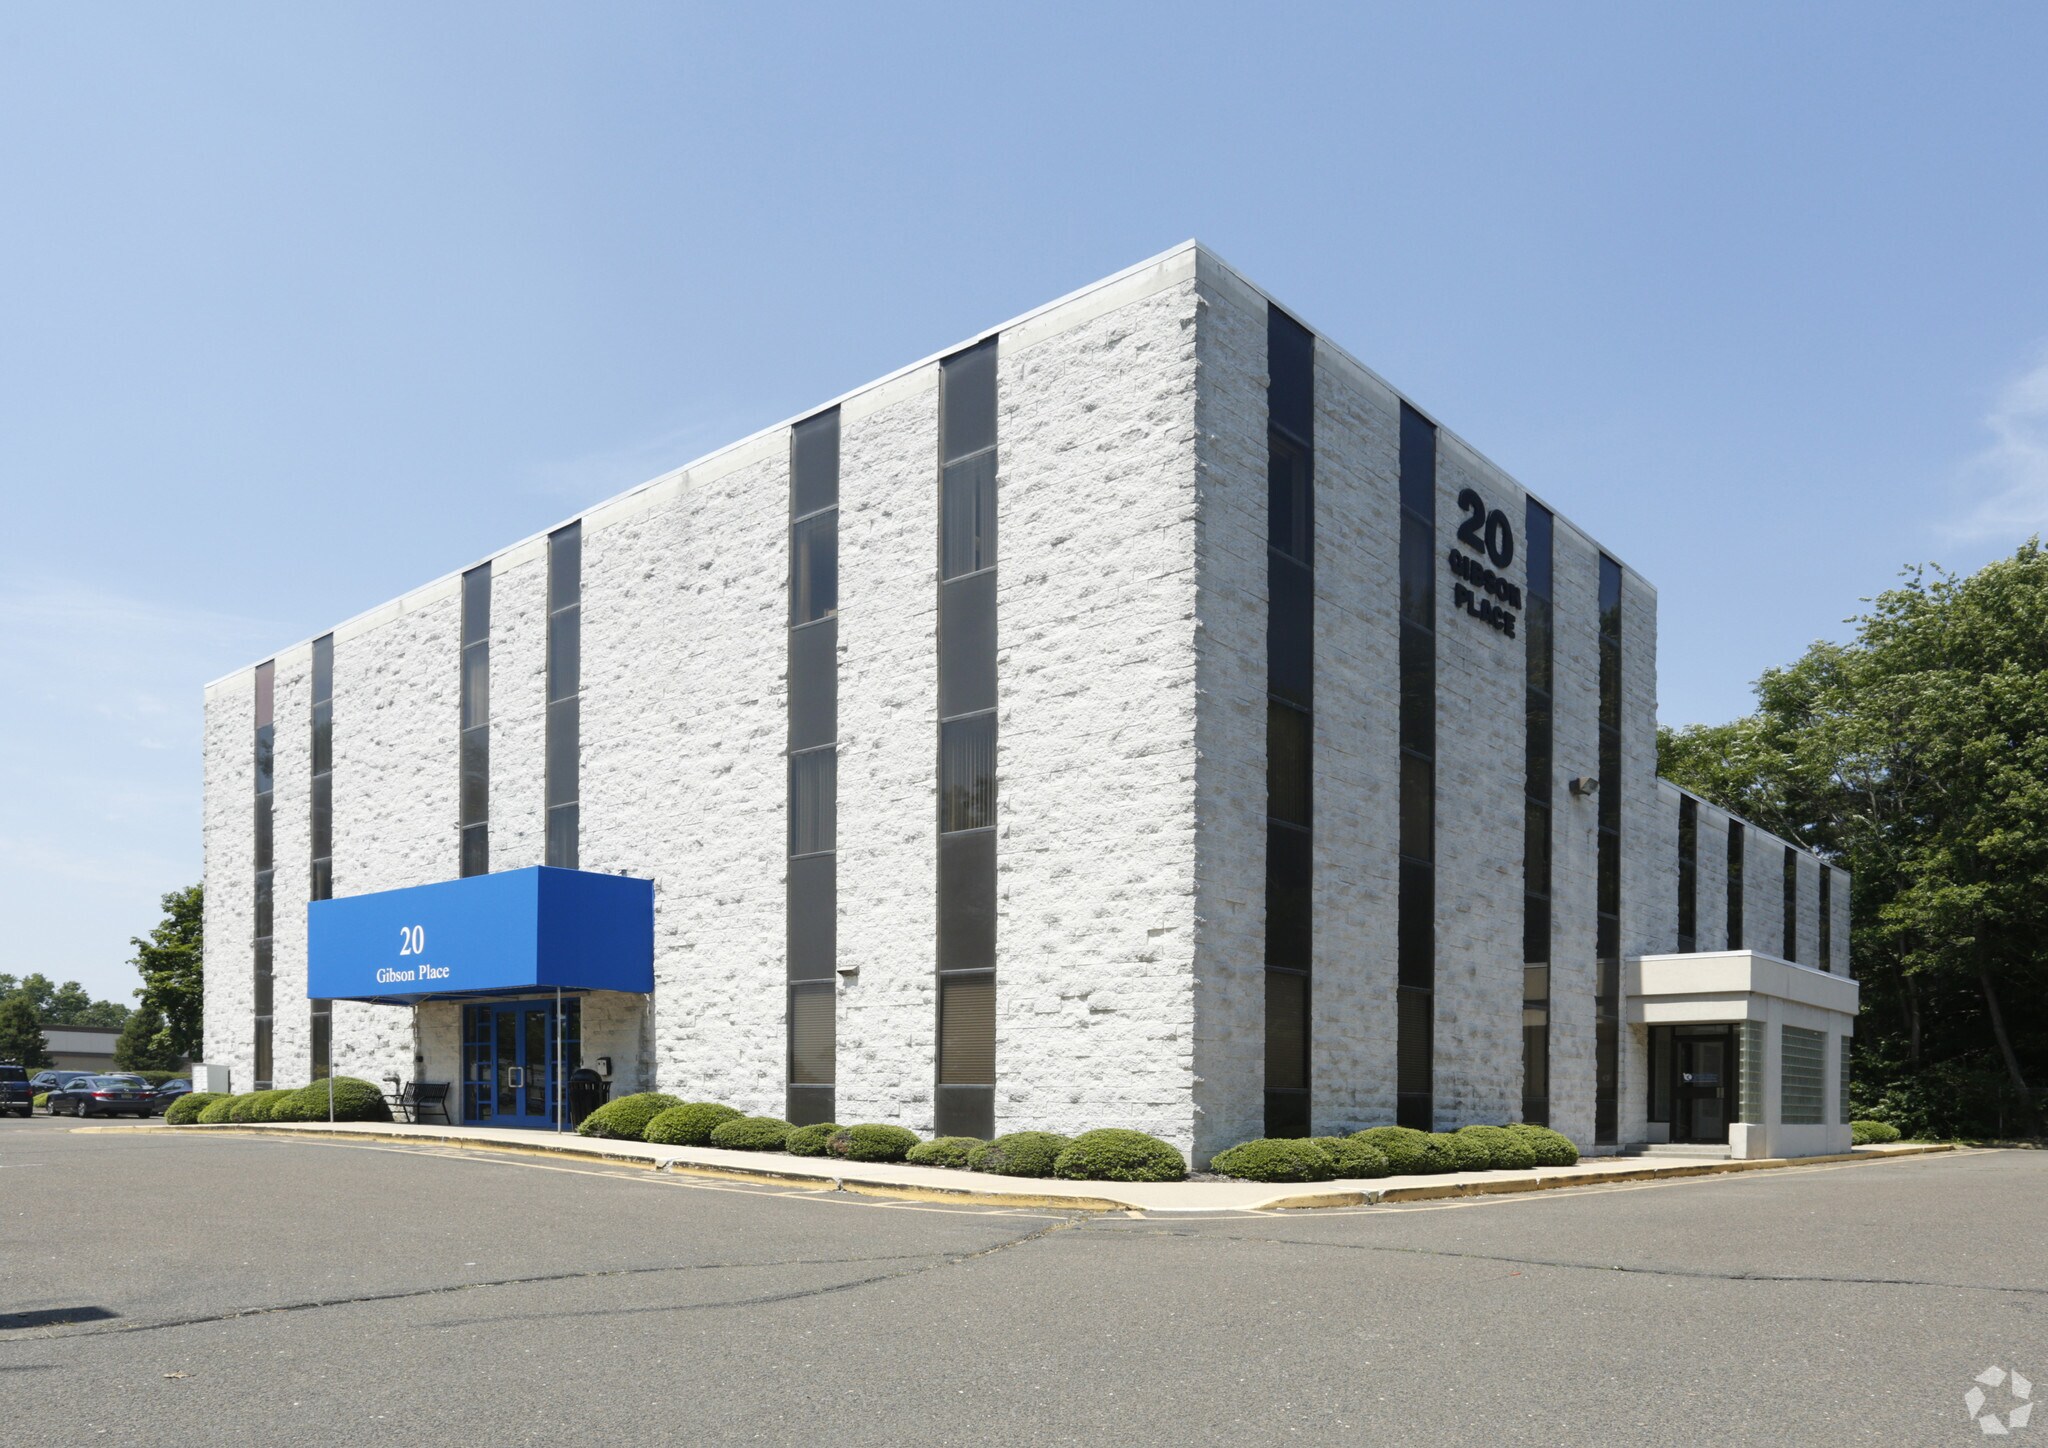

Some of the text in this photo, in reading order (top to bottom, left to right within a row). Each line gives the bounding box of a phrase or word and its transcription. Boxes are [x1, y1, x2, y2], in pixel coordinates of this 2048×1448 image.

[1457, 488, 1513, 568] 20
[1449, 549, 1521, 610] GIBSON
[1454, 582, 1515, 639] PLACE
[400, 925, 424, 955] 20
[376, 964, 450, 983] Gibson Place
